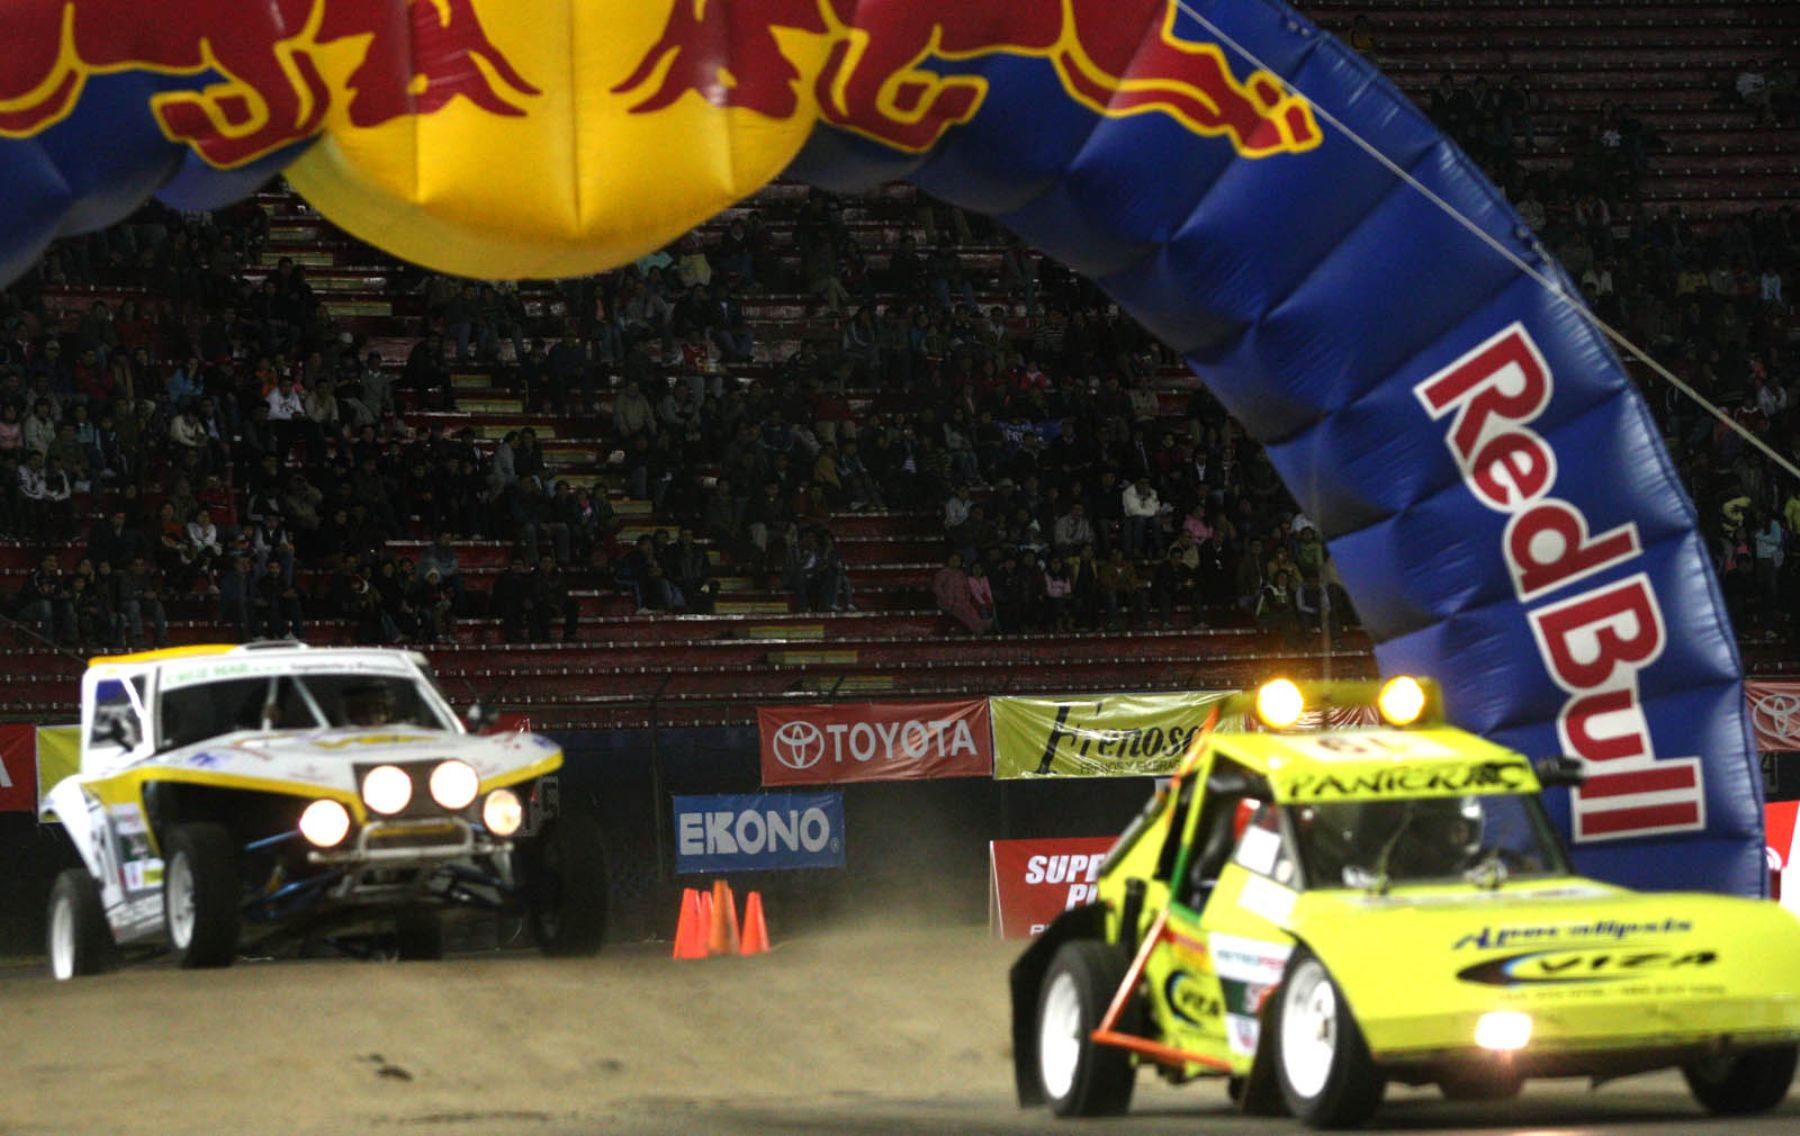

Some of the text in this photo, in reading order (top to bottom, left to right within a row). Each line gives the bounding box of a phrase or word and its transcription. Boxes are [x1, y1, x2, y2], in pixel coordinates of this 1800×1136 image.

[1413, 320, 1643, 603] Red
[826, 719, 978, 763] TOYOTA
[1526, 572, 1706, 844] Bull
[679, 807, 831, 855] EKONO
